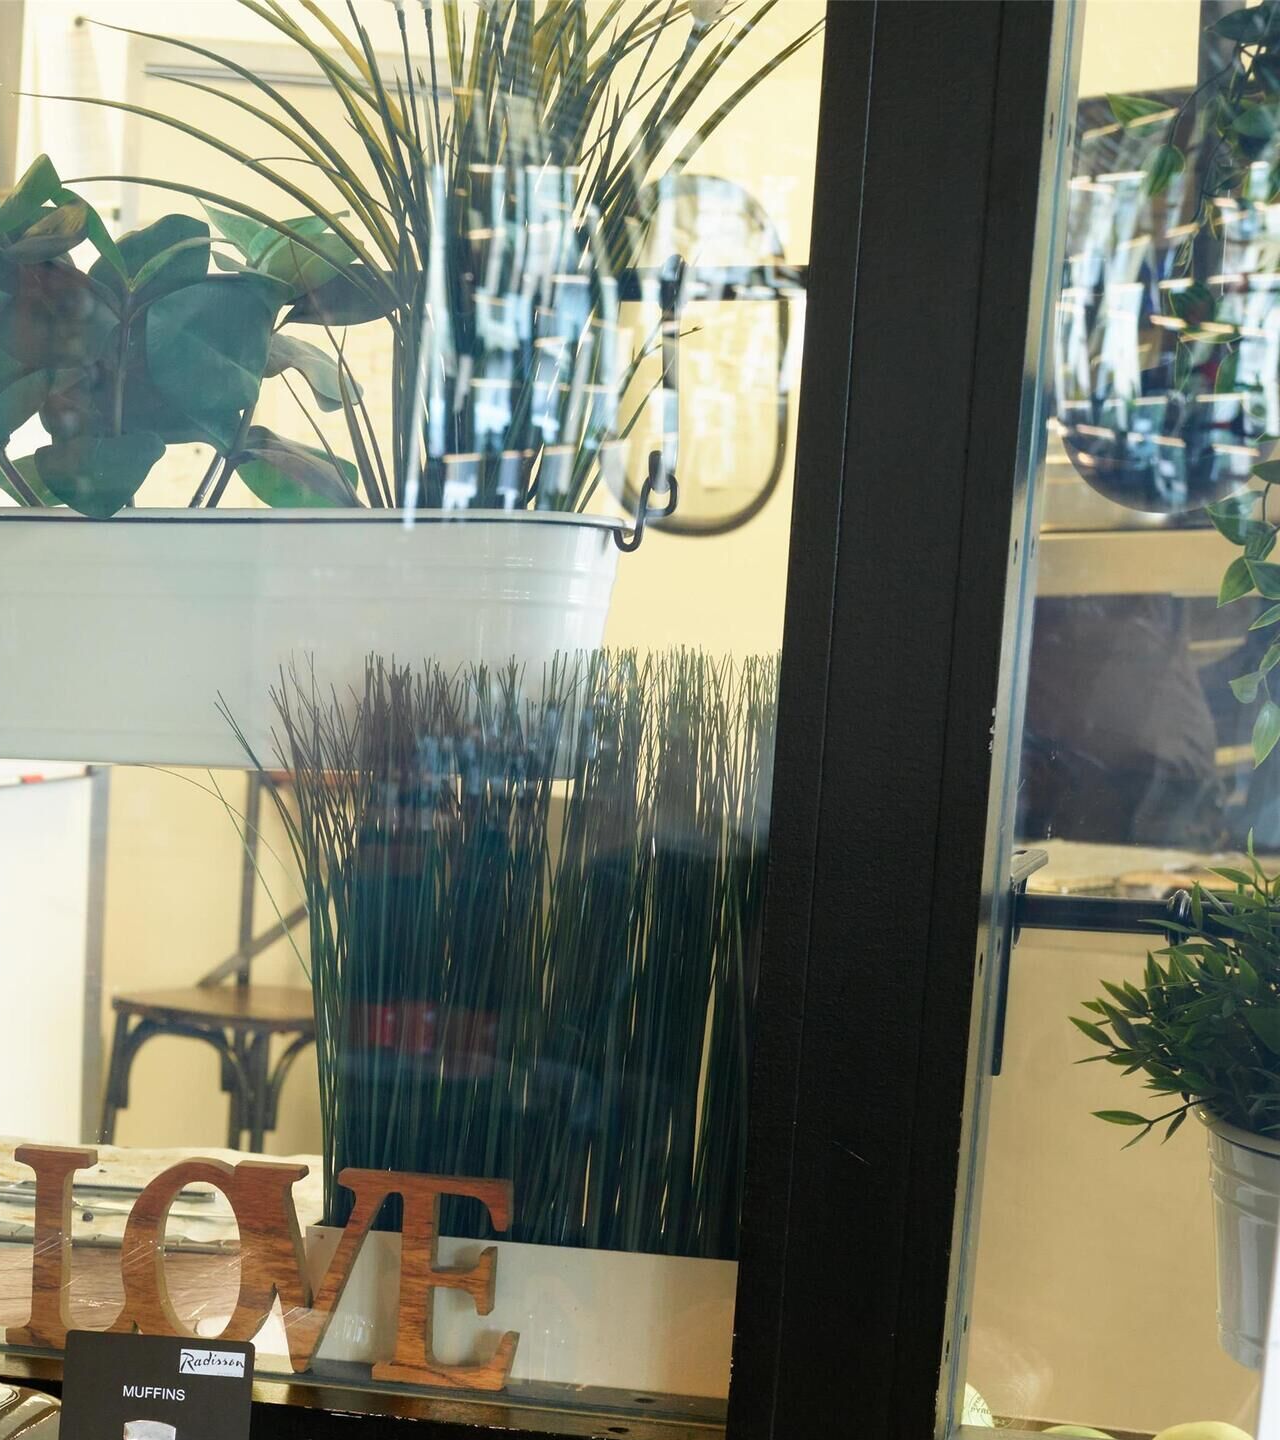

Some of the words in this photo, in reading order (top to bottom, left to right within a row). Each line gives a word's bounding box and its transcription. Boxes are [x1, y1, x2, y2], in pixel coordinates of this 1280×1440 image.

[6, 1143, 514, 1391] LOVE
[180, 1351, 245, 1372] Radisson
[122, 1385, 186, 1401] MUFFINS
